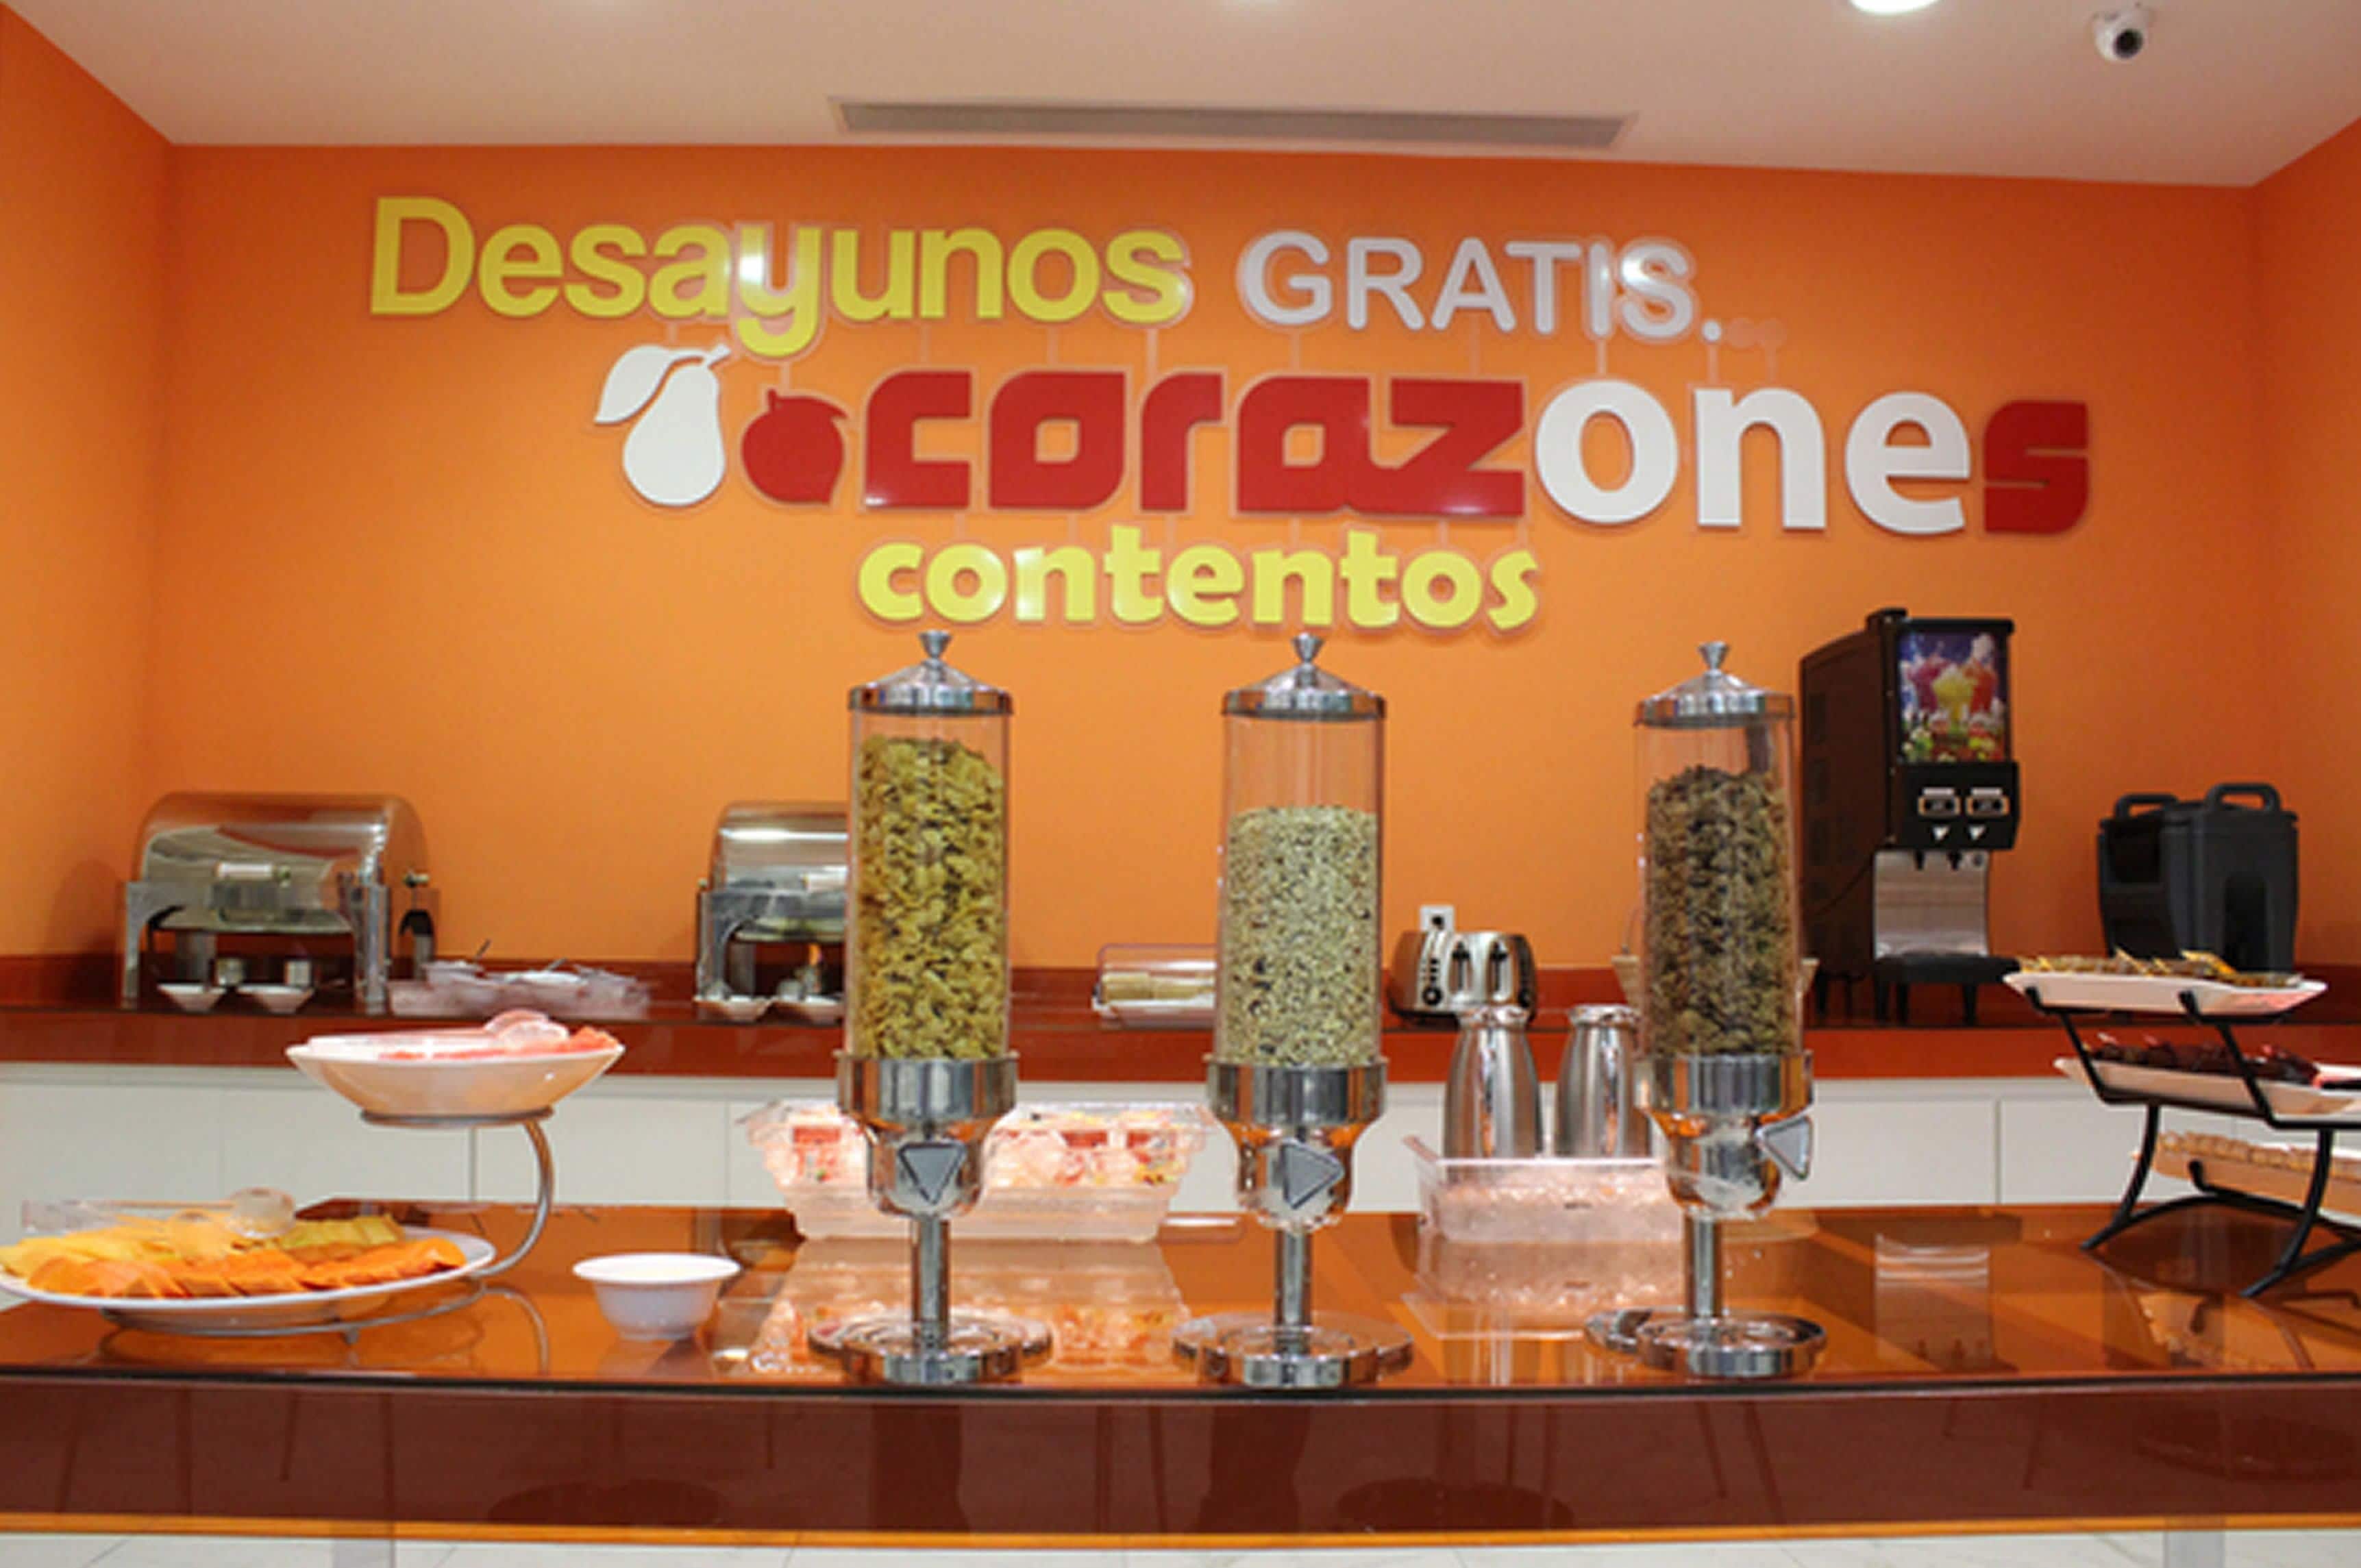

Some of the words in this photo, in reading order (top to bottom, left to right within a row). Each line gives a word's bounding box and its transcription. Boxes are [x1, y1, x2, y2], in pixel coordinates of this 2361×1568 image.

[371, 197, 1191, 356] Desayunos
[865, 370, 2090, 535] corazones
[858, 525, 1538, 630] contentos
